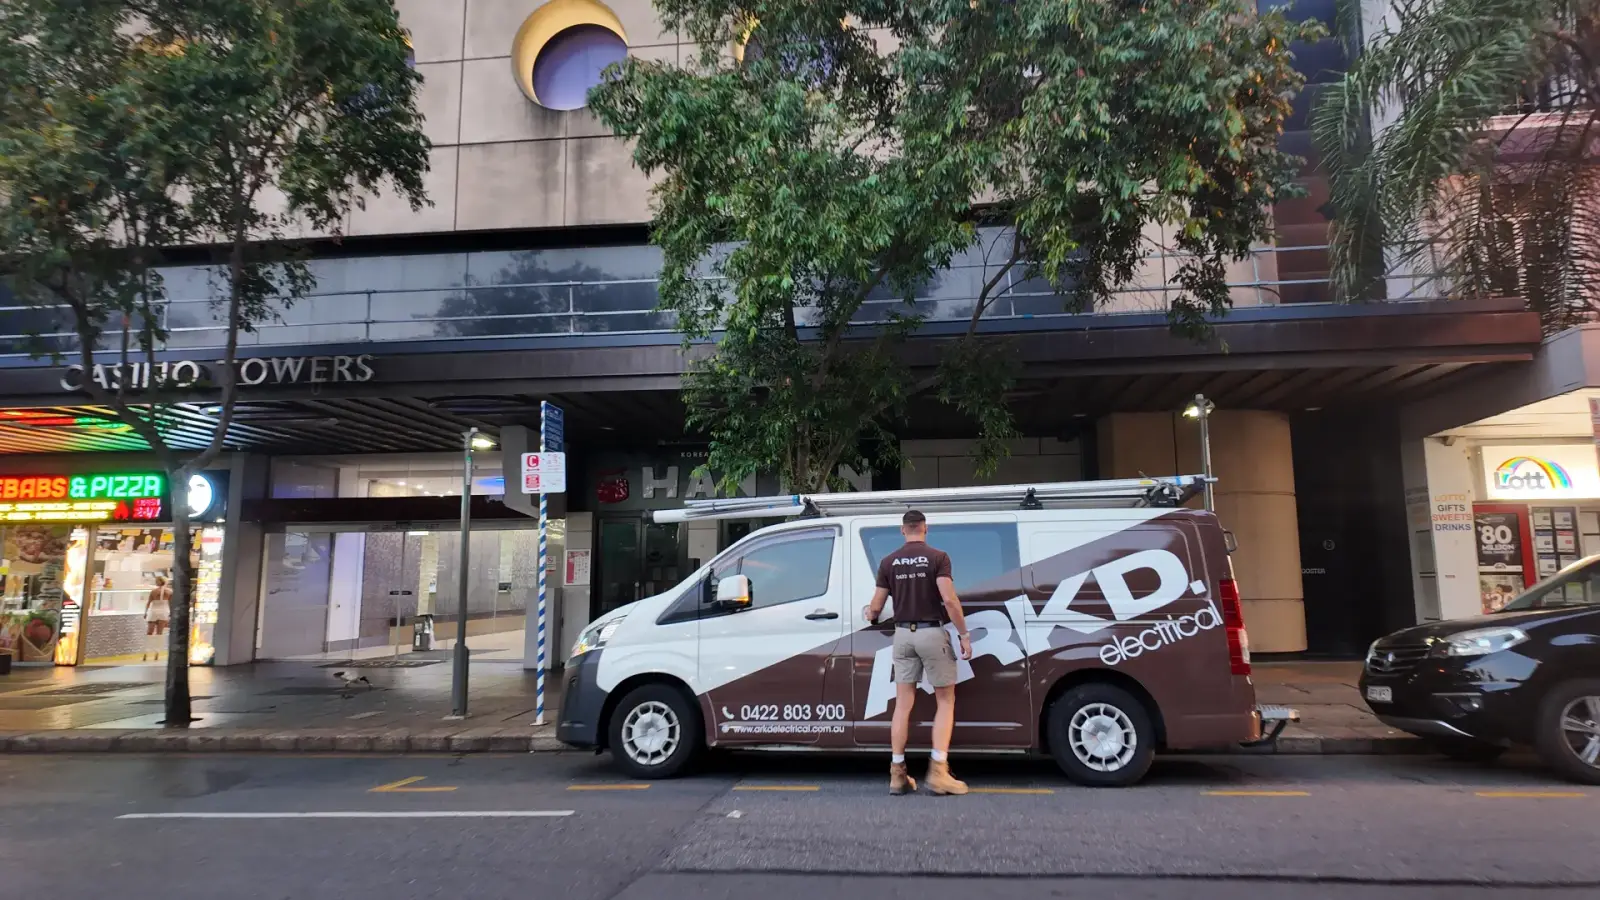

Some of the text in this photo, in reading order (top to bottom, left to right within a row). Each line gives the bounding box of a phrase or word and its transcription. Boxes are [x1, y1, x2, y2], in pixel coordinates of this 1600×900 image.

[60, 354, 375, 391] CASINO OWERS
[1493, 471, 1545, 490] Lott
[0, 476, 161, 498] BABS & PIZZA
[1434, 494, 1466, 502] LOTTO
[1437, 504, 1465, 512] GIFTS
[1432, 513, 1472, 521] SWEETS
[1434, 523, 1471, 531] DRINKS
[892, 556, 929, 566] ARKD.
[1100, 599, 1223, 665] electrical
[740, 704, 845, 720] 0422 803 900
[734, 724, 845, 734] www.arkdelectrical.com.au
